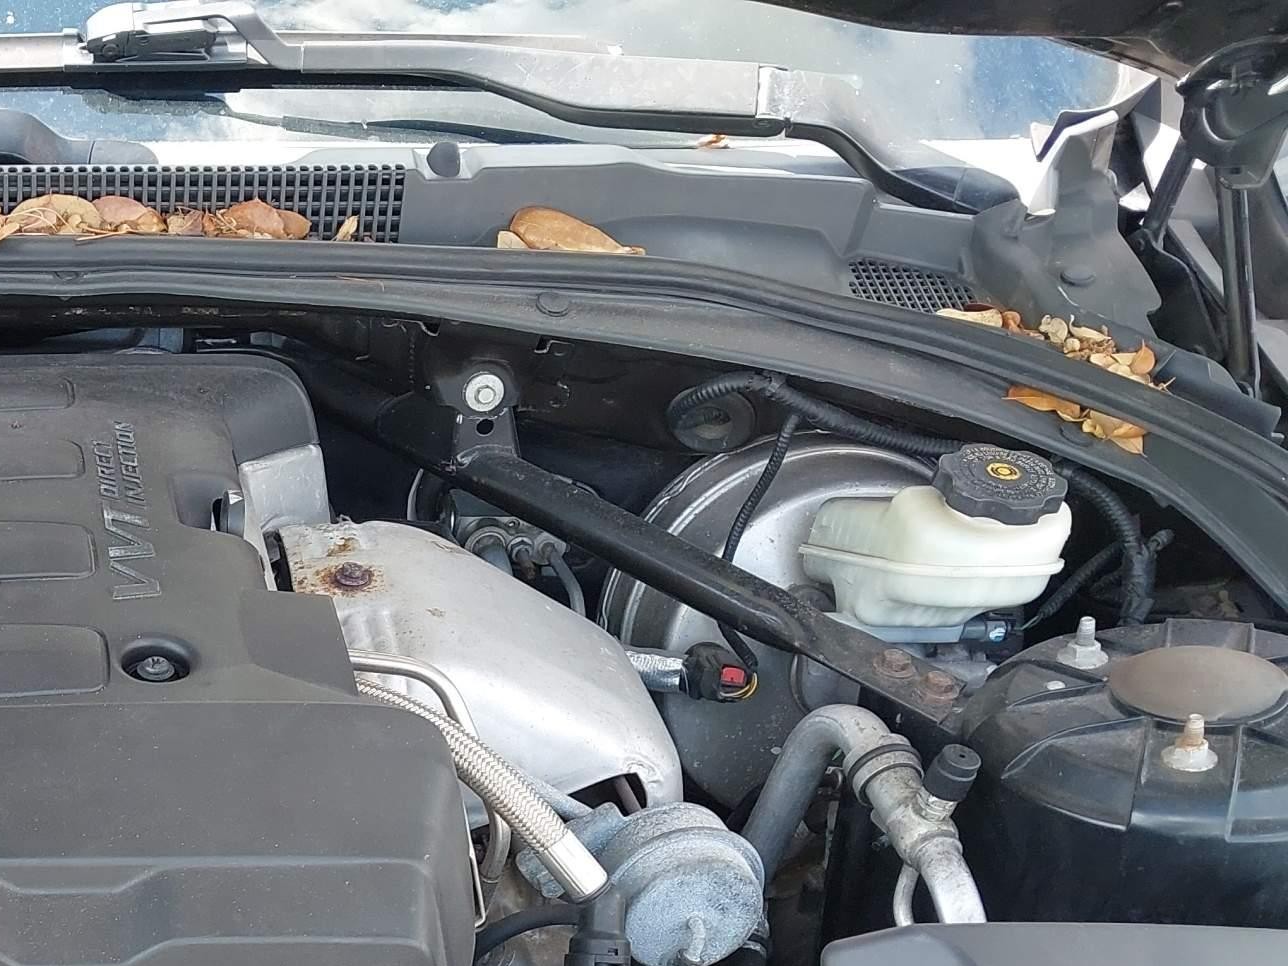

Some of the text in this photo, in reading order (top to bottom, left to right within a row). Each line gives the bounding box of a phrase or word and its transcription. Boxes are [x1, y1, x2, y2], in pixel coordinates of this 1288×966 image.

[92, 439, 120, 500] DIRECT
[114, 421, 147, 508] INJECTION
[102, 501, 162, 600] VVT
